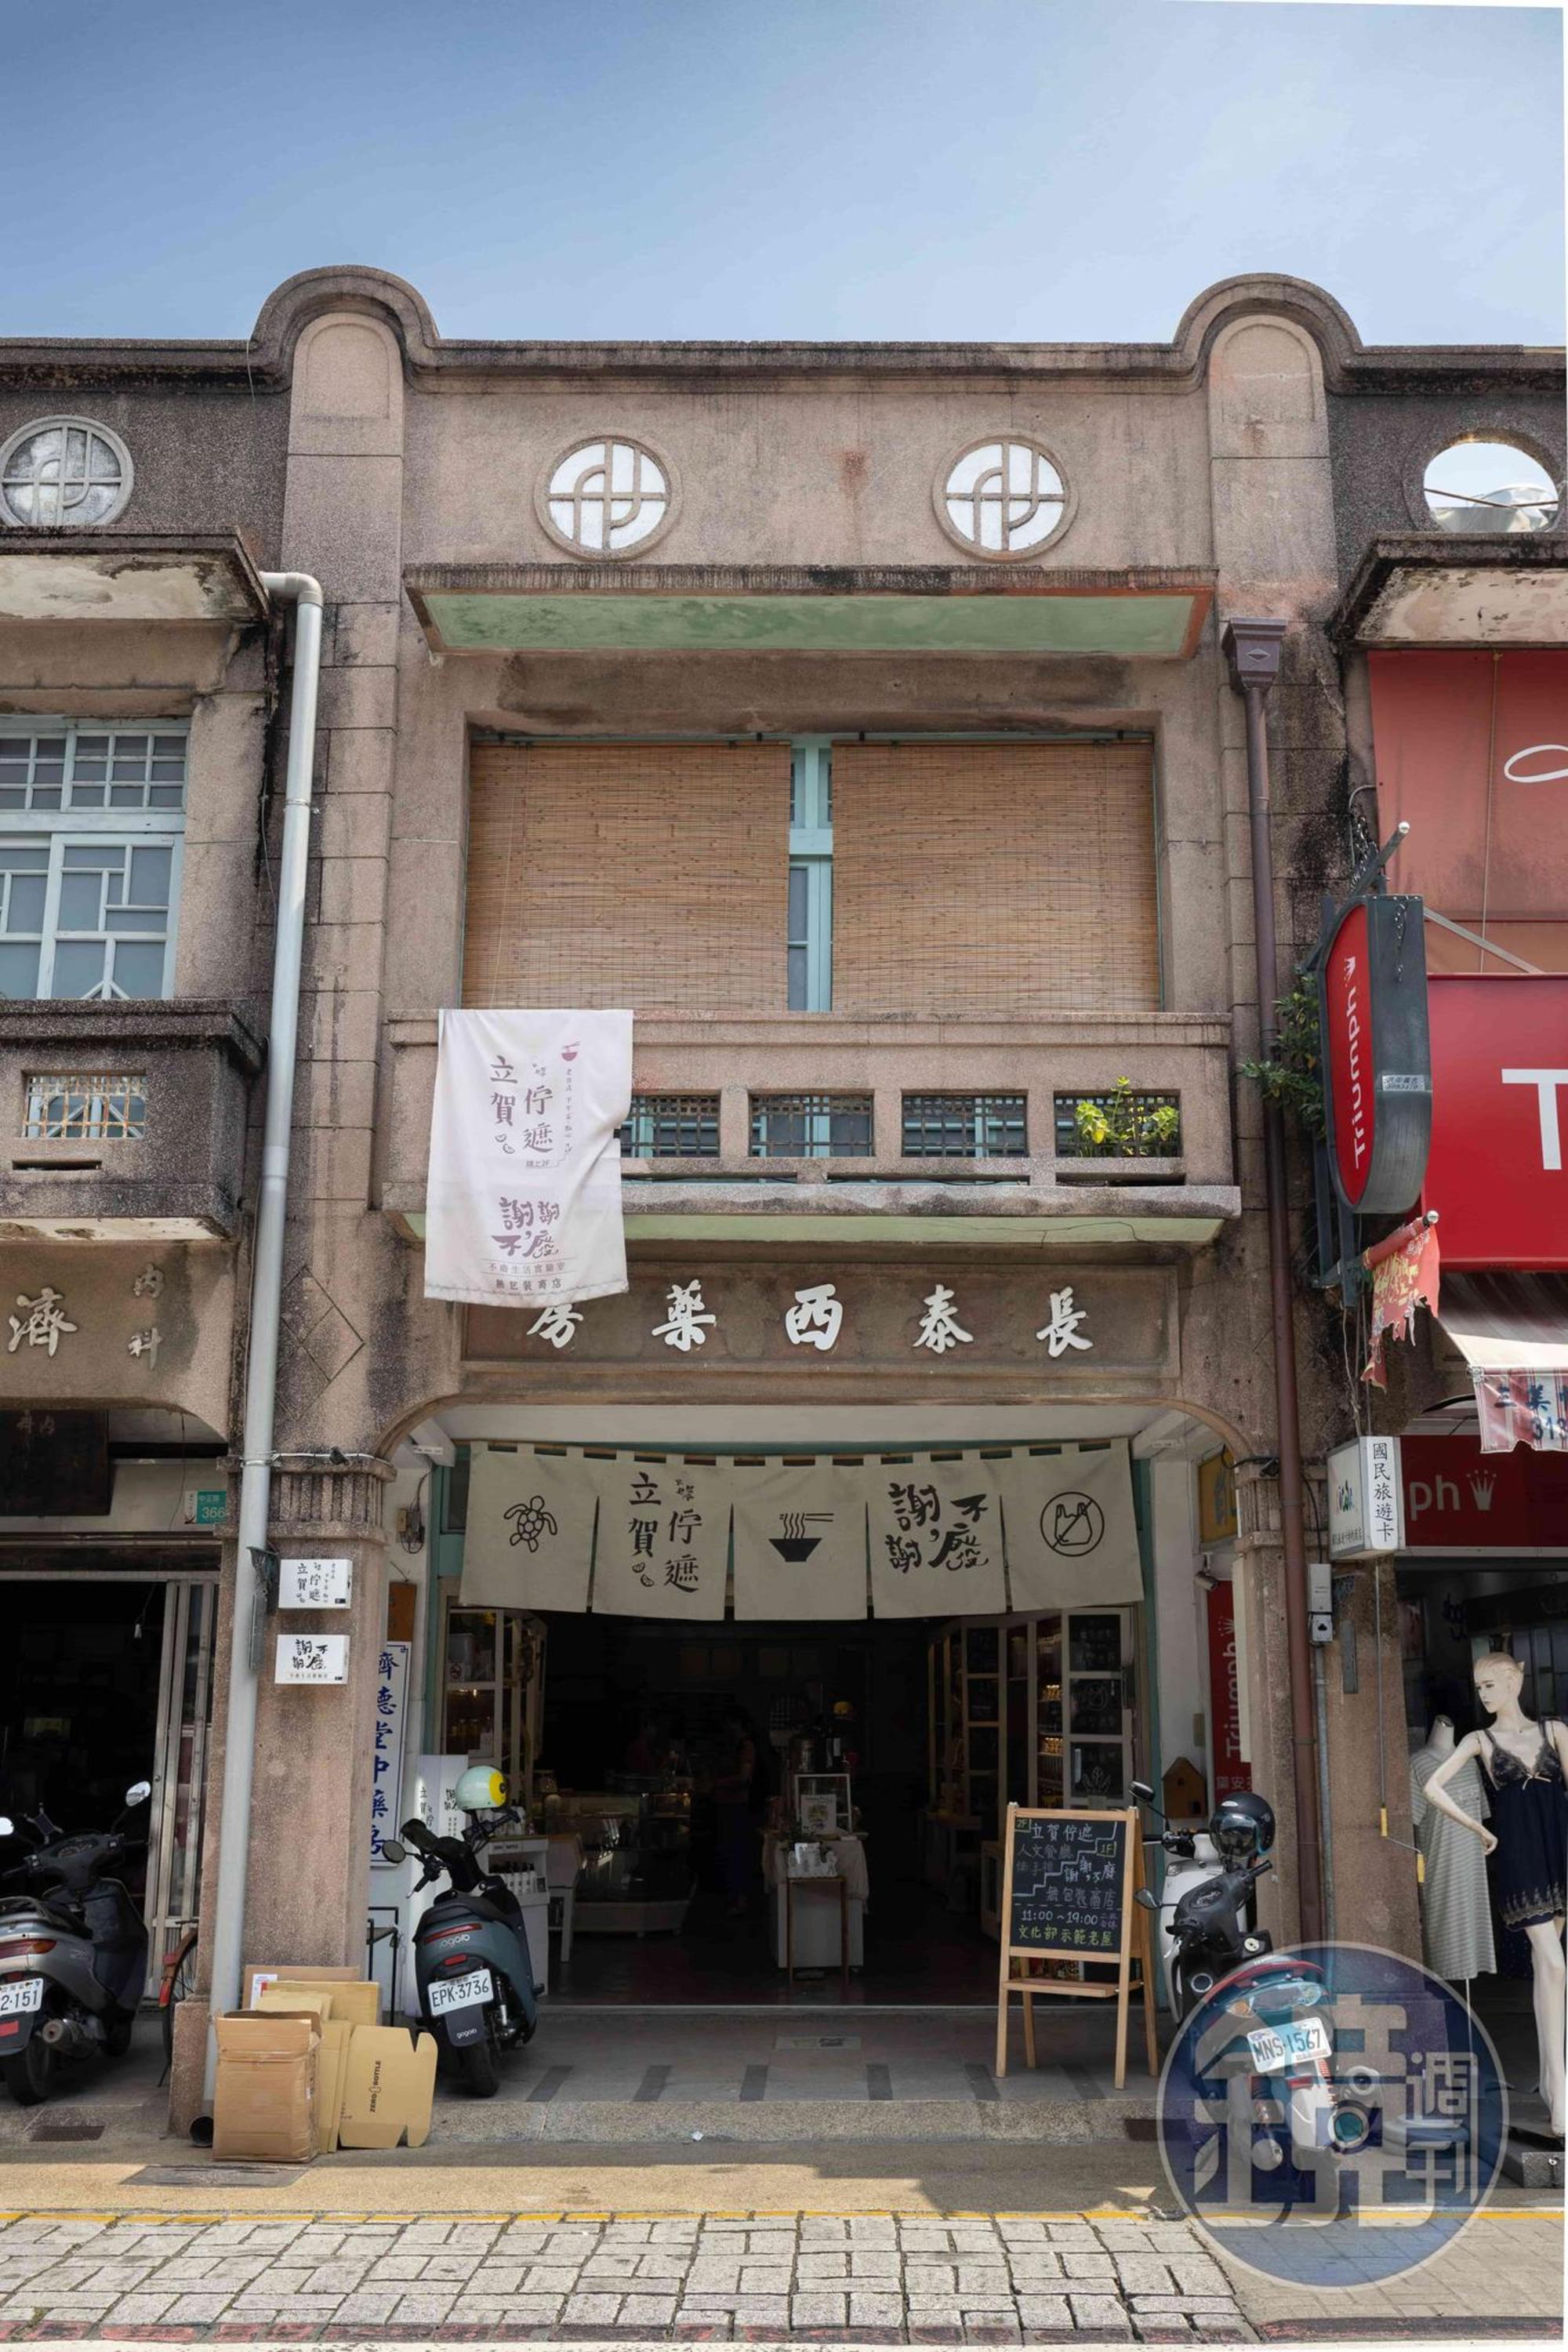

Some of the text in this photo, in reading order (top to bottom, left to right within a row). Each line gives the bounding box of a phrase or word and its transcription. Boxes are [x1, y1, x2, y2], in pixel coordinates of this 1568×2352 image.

[489, 1054, 518, 1127] 立賀
[1346, 985, 1367, 1170] Triumph
[523, 1084, 554, 1153] 佇遮
[1373, 1443, 1394, 1542] 國民旅遊卡
[201, 1507, 226, 1519] 366
[628, 1471, 662, 1558] 立賀
[664, 1508, 702, 1593] 佇遮
[1016, 1819, 1028, 1828] 2F
[1032, 1823, 1096, 1842] 立賀佇遮
[1100, 1843, 1113, 1853] 1F
[1018, 1924, 1113, 1947] 文化部示範老屋
[1252, 2028, 1321, 2063] MNS-1567
[372, 2060, 382, 2086] BOTTLE
